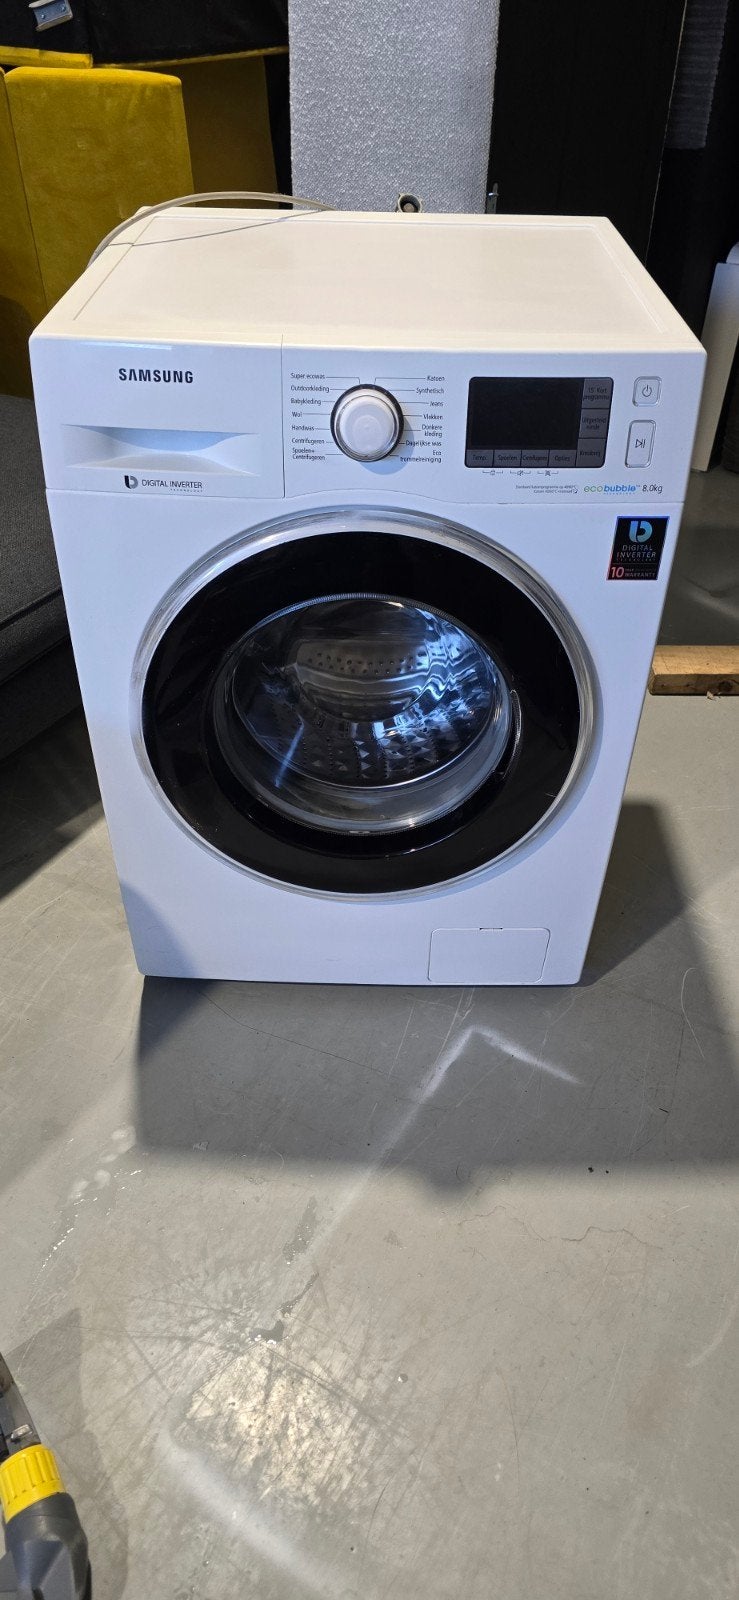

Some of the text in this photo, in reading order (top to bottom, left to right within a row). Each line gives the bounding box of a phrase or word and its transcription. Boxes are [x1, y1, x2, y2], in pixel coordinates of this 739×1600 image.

[118, 367, 194, 384] SAMSUNG
[290, 372, 305, 380] Super
[290, 385, 330, 393] Outdoorkleding
[416, 387, 444, 395] Synthetisch
[290, 397, 322, 406] Babykleding
[424, 430, 443, 438] kleding
[291, 437, 325, 445] Centrifugeren
[141, 479, 169, 488] DIGITAL
[169, 480, 203, 489] INVERTER
[642, 484, 663, 495] 8.0kg
[610, 566, 625, 578] 10
